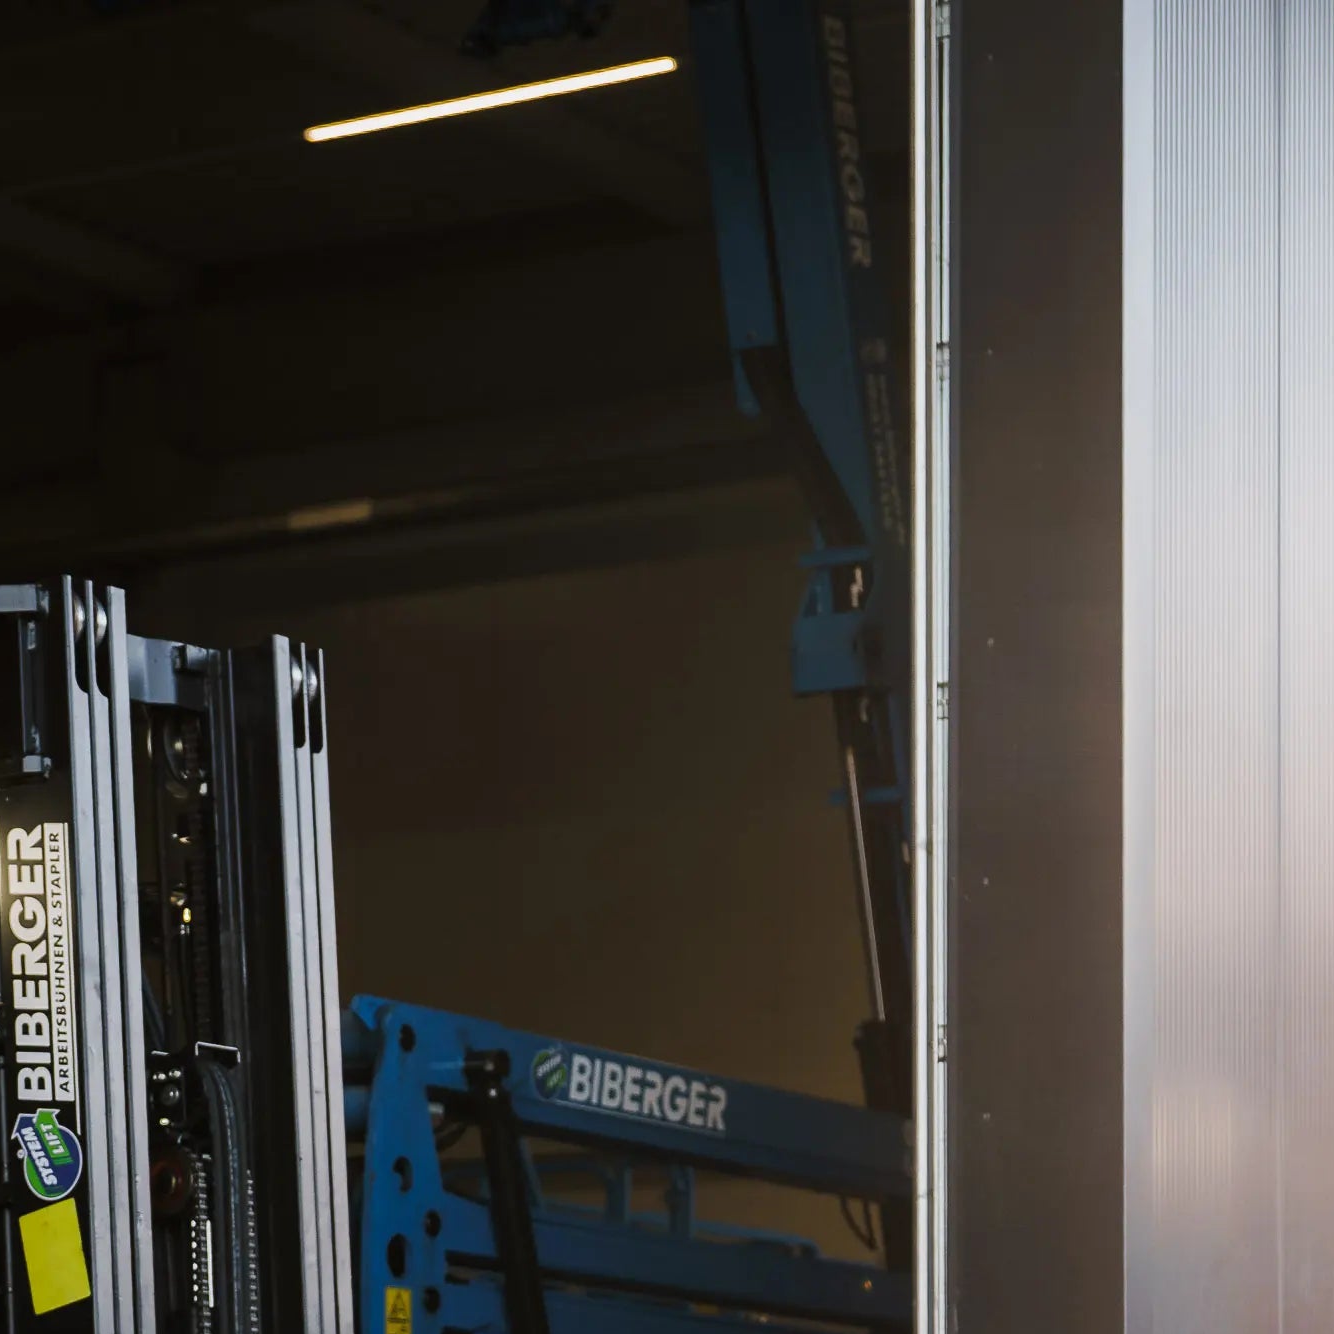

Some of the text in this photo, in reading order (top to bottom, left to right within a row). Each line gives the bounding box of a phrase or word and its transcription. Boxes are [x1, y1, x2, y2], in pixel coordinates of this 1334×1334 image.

[7, 823, 53, 1101] BIBERGER
[48, 832, 70, 1093] ARBEITSBÜHNEN & STAPLER
[569, 1053, 728, 1131] BIBERGER
[20, 1126, 58, 1185] SYSTEM
[40, 1123, 65, 1154] LIFT
